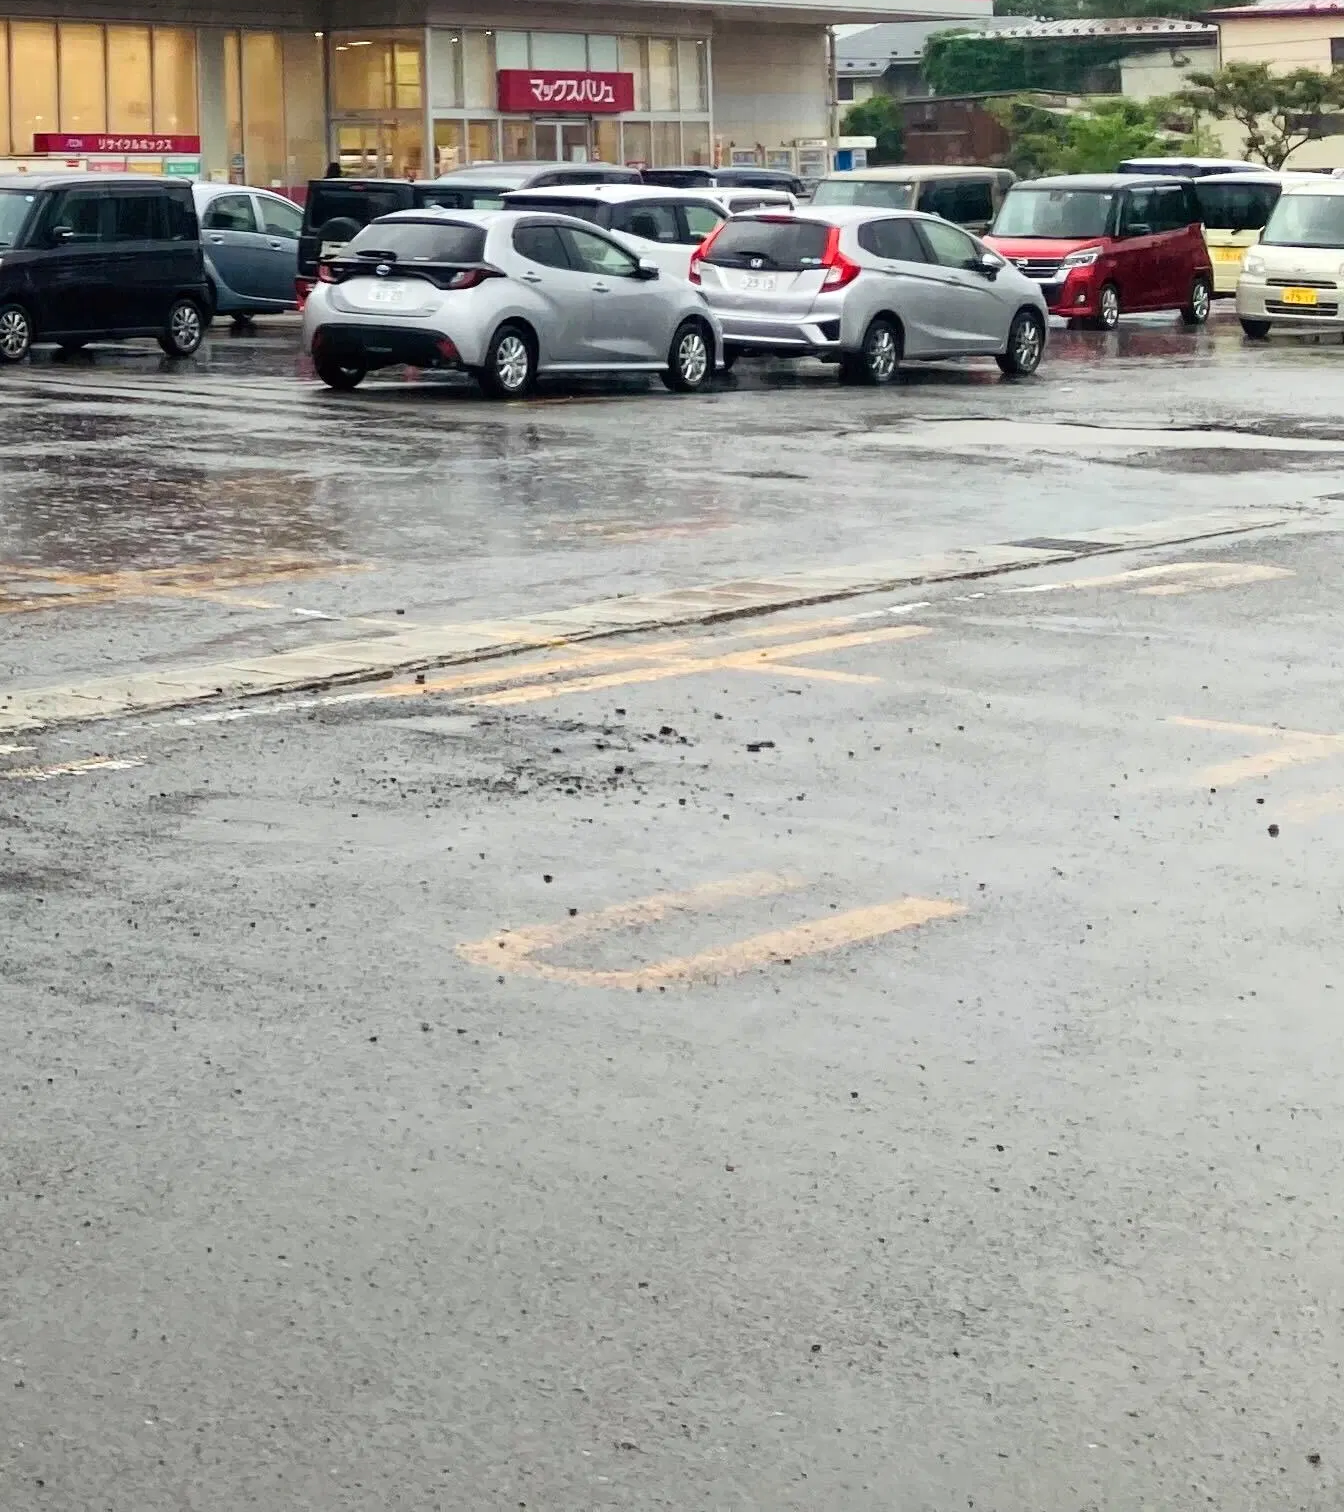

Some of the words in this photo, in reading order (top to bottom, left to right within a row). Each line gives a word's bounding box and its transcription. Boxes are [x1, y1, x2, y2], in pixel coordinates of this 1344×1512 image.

[529, 79, 616, 103] マックスバリュ
